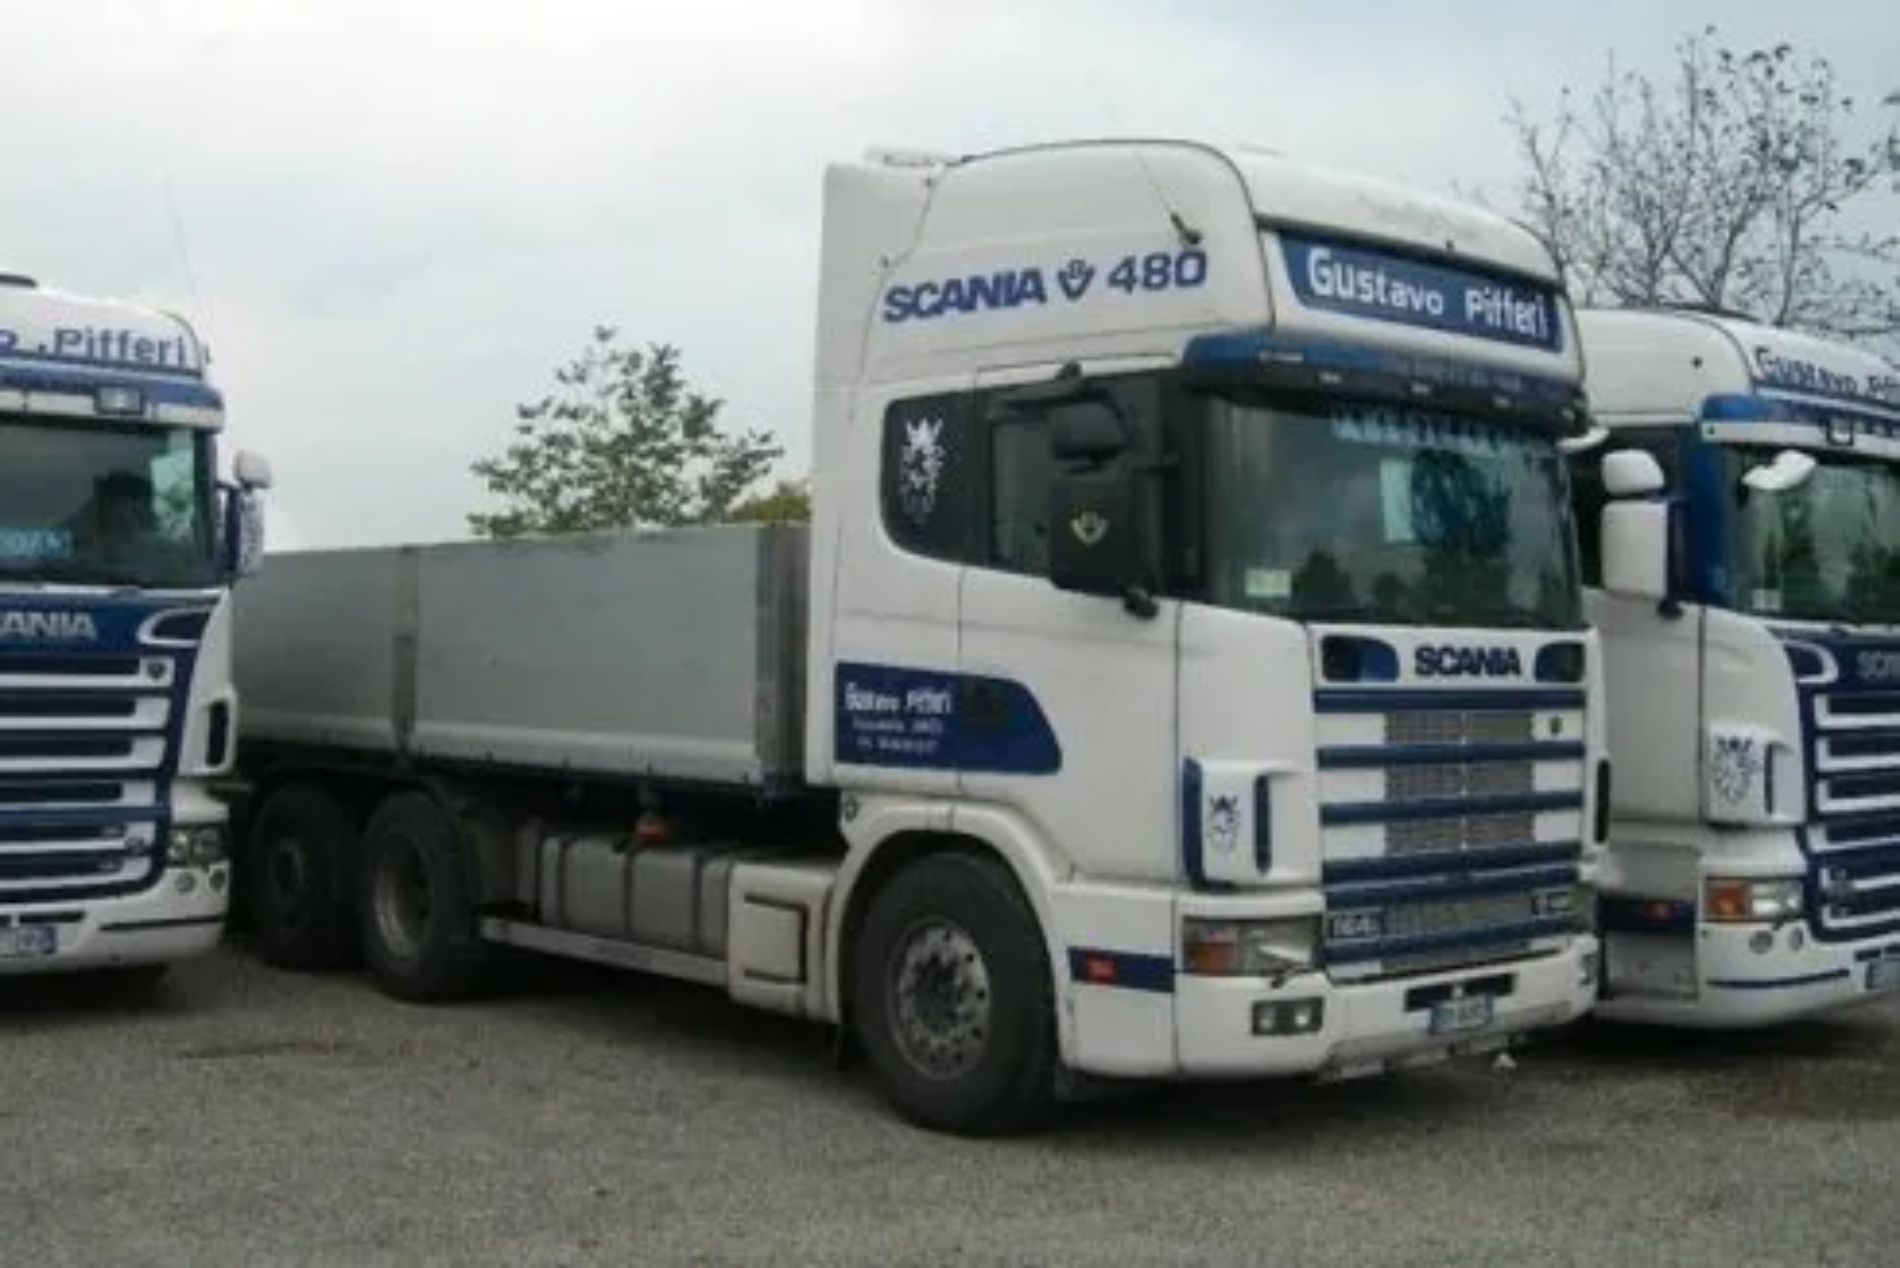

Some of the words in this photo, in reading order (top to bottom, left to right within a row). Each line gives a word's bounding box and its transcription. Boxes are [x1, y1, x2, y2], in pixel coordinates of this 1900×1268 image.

[883, 268, 1047, 323] SCANIA
[1107, 250, 1207, 294] 480
[1308, 247, 1444, 316] Gustavo
[1464, 285, 1548, 340] Pifferi
[1415, 643, 1521, 676] SCANIA
